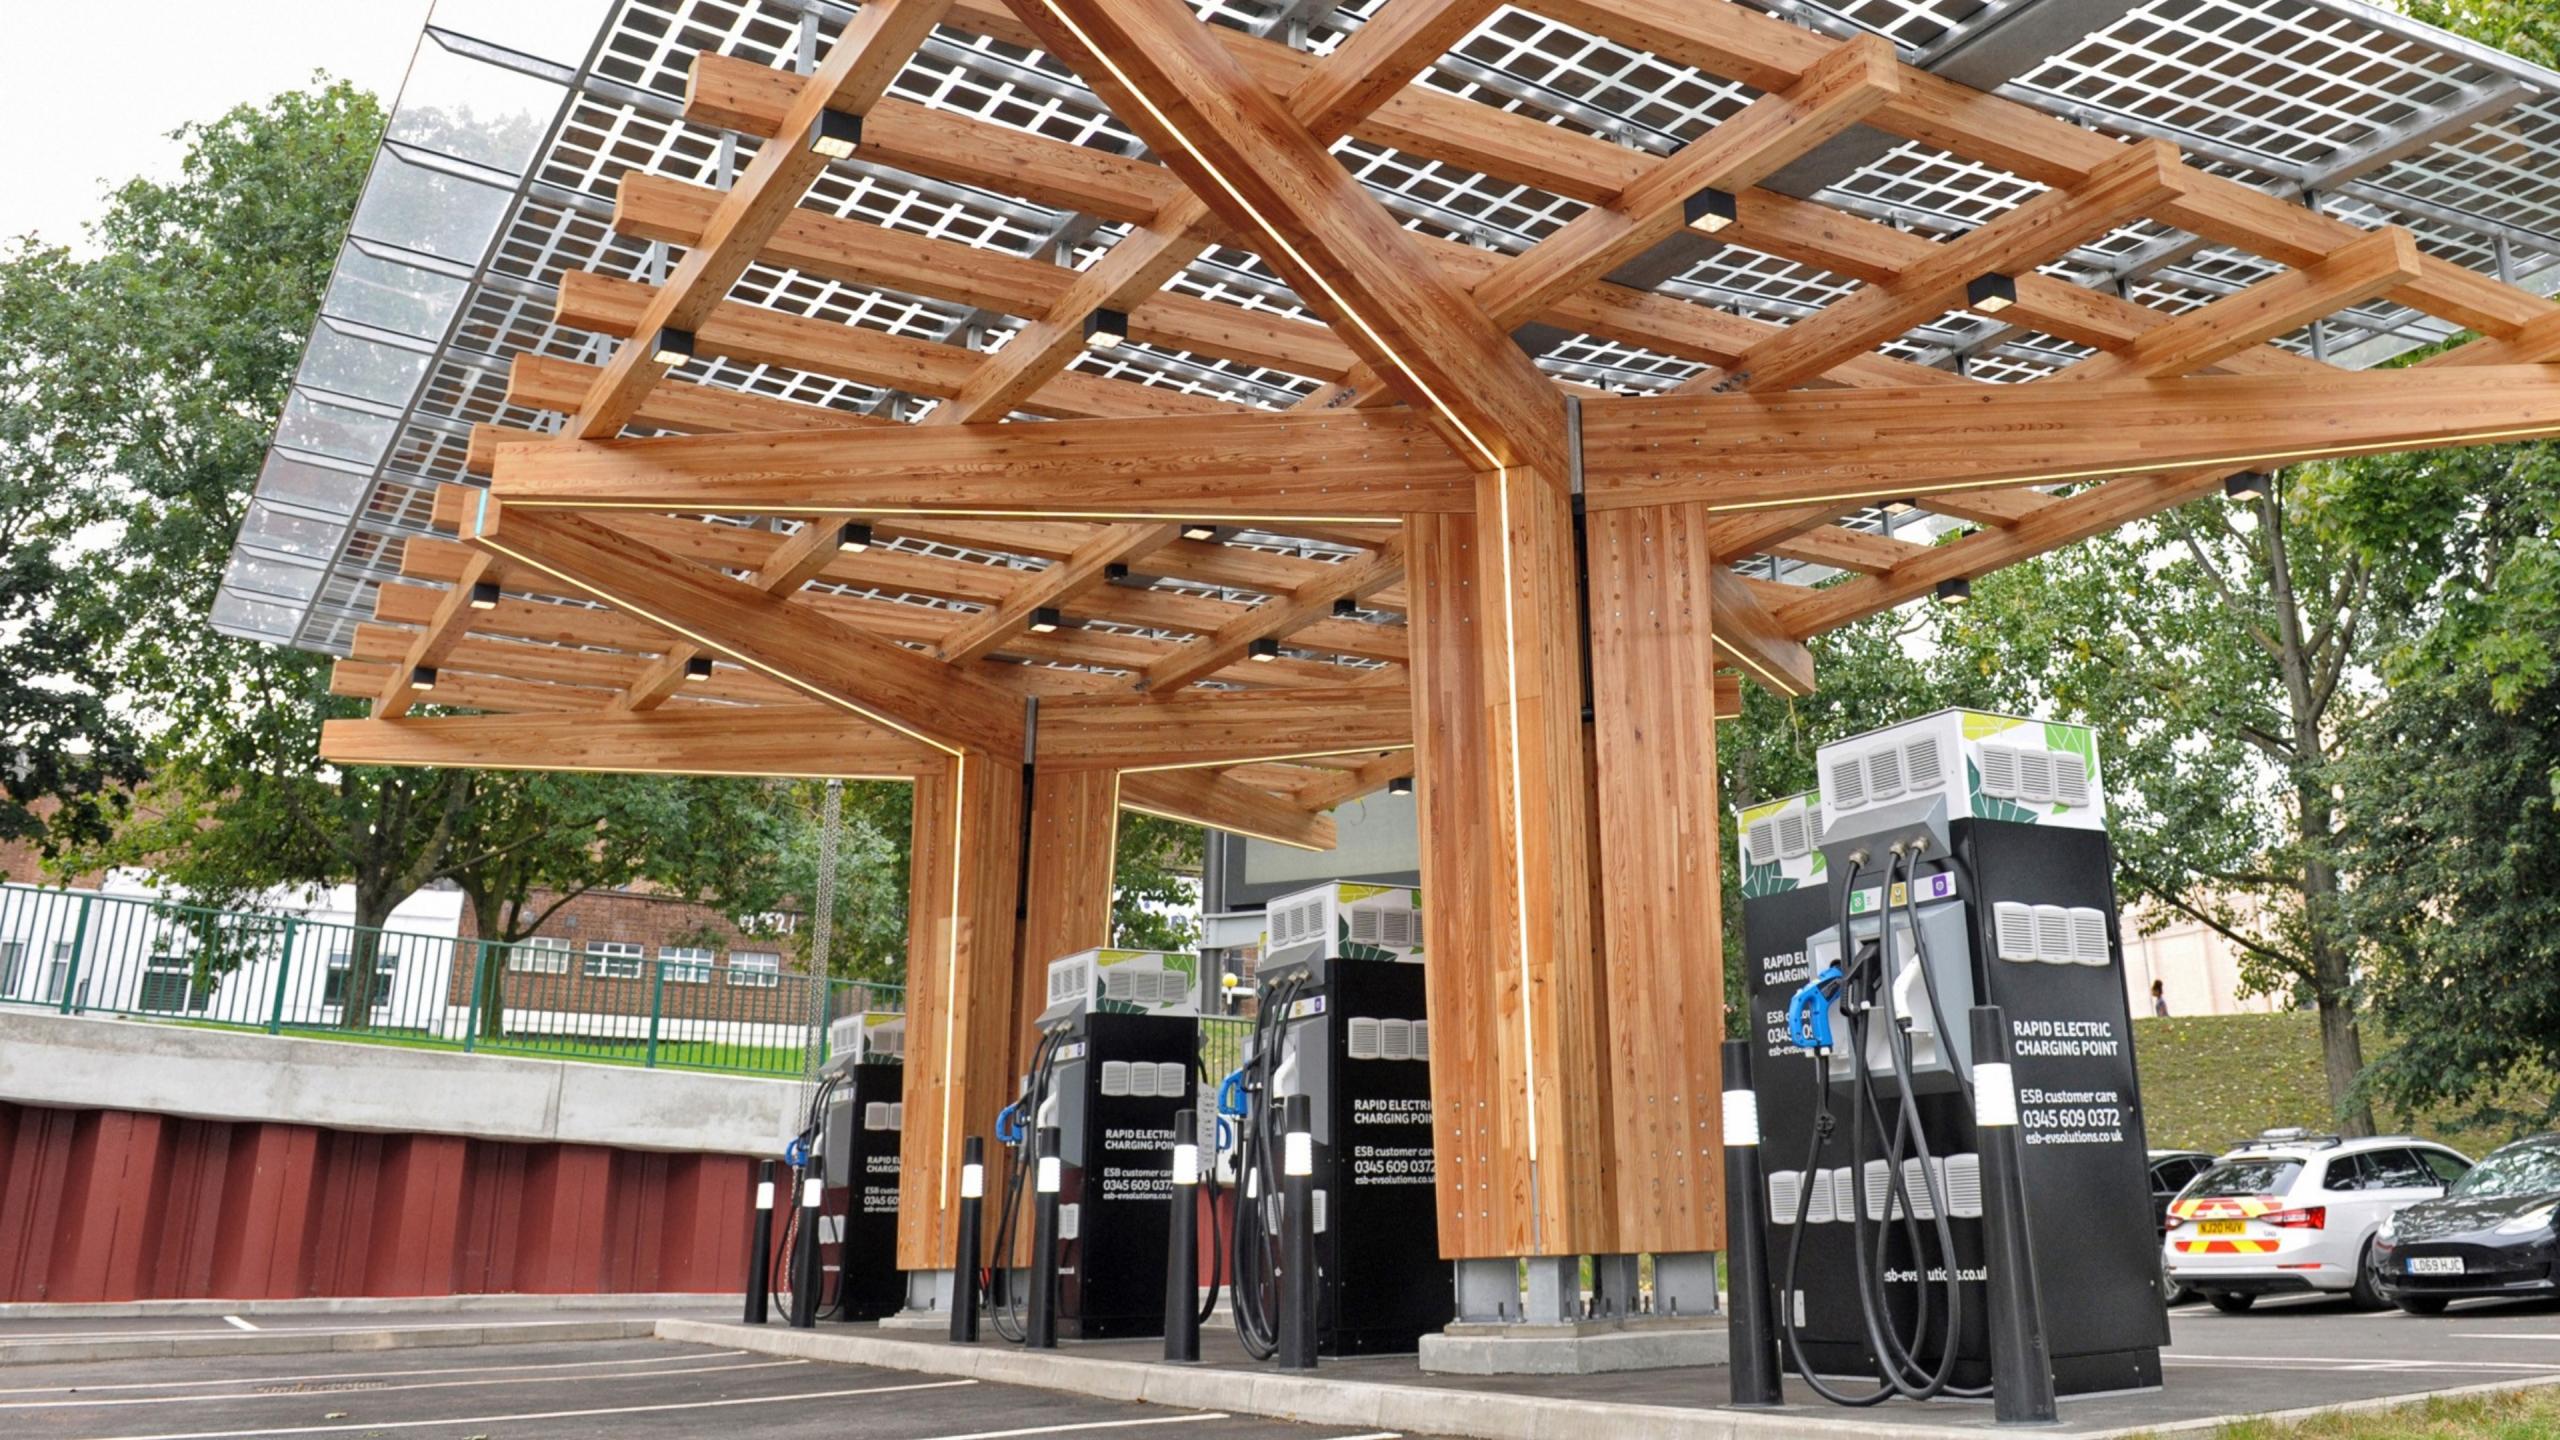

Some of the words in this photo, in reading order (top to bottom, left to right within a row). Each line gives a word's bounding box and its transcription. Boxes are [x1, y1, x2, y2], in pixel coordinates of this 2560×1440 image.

[1763, 953, 1793, 969] RAPID
[1764, 967, 1808, 986] CHARGIN
[1767, 1010, 1784, 1024] ESB
[2013, 1021, 2052, 1036] RAPID
[2053, 1022, 2112, 1037] ELECTRIC
[2015, 1040, 2080, 1056] CHARGING
[2081, 1041, 2118, 1056] POINT
[2021, 1089, 2043, 1104] ESB
[2045, 1090, 2095, 1104] customer
[2095, 1091, 2118, 1103] care
[1354, 1099, 1387, 1110] RAPID
[1388, 1100, 1432, 1111] ELECTRI
[1354, 1112, 1409, 1124] CHARGING
[1411, 1113, 1433, 1124] POIN
[2023, 1110, 2058, 1128] 0345
[2060, 1109, 2086, 1127] 609
[2087, 1109, 2121, 1126] 0372
[1105, 1129, 1134, 1139] RAPID
[1105, 1140, 1153, 1150] CHARGING
[1155, 1141, 1175, 1150] POIN
[1355, 1146, 1374, 1157] ESB
[1375, 1147, 1417, 1157] customer
[1418, 1147, 1434, 1156] car
[867, 1156, 891, 1164] RAPID
[866, 1165, 900, 1173] CHARGIN
[1104, 1168, 1121, 1177] ESB
[1122, 1168, 1159, 1177] customer
[1160, 1169, 1173, 1177] car
[1354, 1160, 1384, 1173] 0345
[1386, 1160, 1408, 1173] 609
[1103, 1180, 1129, 1191] 0345
[1130, 1180, 1150, 1191] 609
[1355, 1175, 1435, 1184] esb-evsolutions.co.u
[864, 1196, 886, 1205] 0345
[1103, 1192, 1173, 1200] esb-evsolutions.co.u
[2441, 1259, 2461, 1271] HJC
